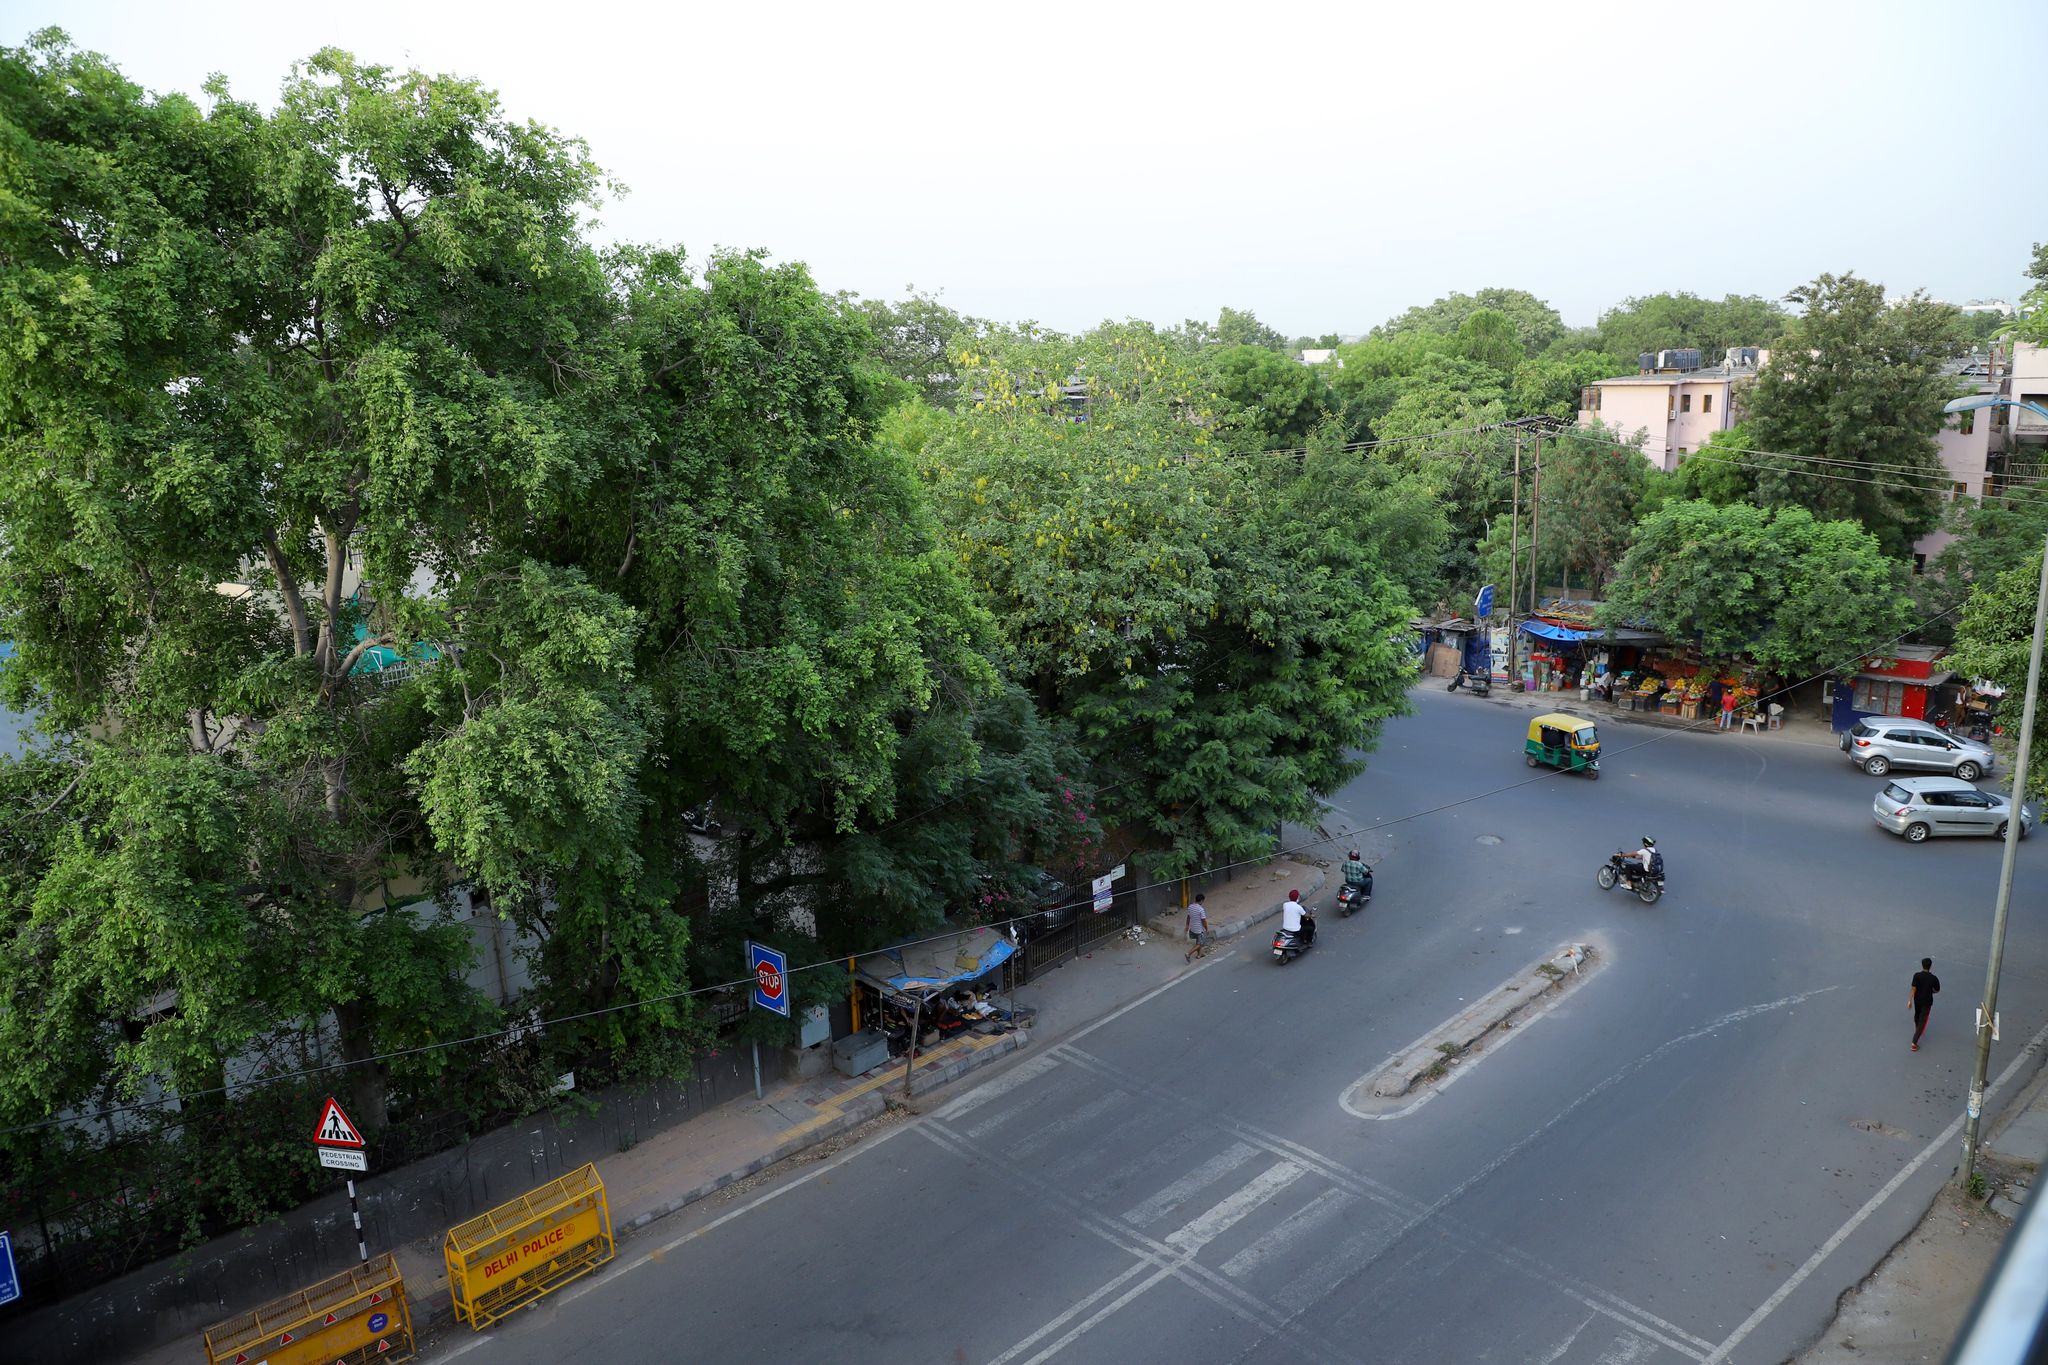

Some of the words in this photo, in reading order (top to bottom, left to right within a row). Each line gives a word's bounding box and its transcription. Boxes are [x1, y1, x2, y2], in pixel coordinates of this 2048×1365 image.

[759, 970, 780, 989] STOP
[320, 1151, 362, 1161] PEDESTRIAN
[325, 1159, 360, 1168] CROSSING
[484, 1251, 519, 1279] DELHI
[522, 1228, 565, 1257] POLICE
